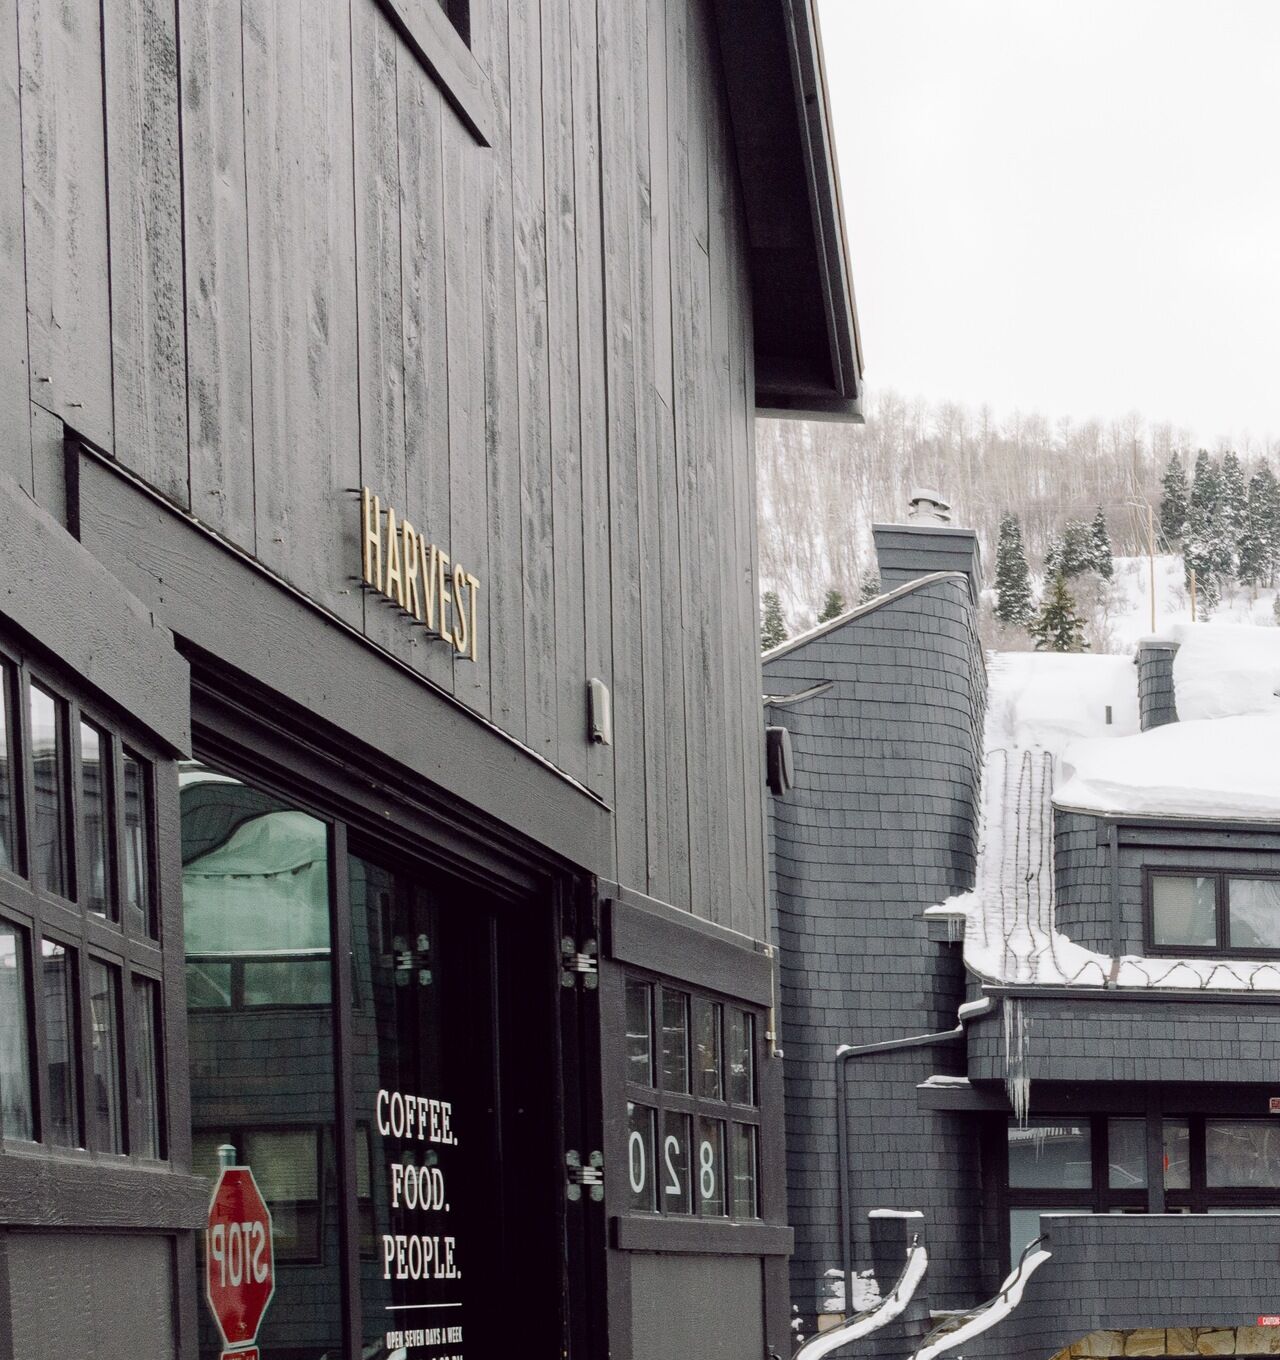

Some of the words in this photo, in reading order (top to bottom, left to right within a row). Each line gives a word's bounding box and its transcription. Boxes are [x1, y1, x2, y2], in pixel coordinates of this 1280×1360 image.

[362, 486, 480, 662] HARVEST
[377, 1089, 458, 1146] COFFEE.
[391, 1163, 450, 1212] FOOD.
[382, 1234, 462, 1280] PEOPLE.
[386, 1331, 403, 1349] OPEN
[405, 1329, 424, 1347] SEVEN
[425, 1328, 441, 1345] DAYS
[441, 1327, 447, 1344] A
[447, 1326, 463, 1343] WEEK
